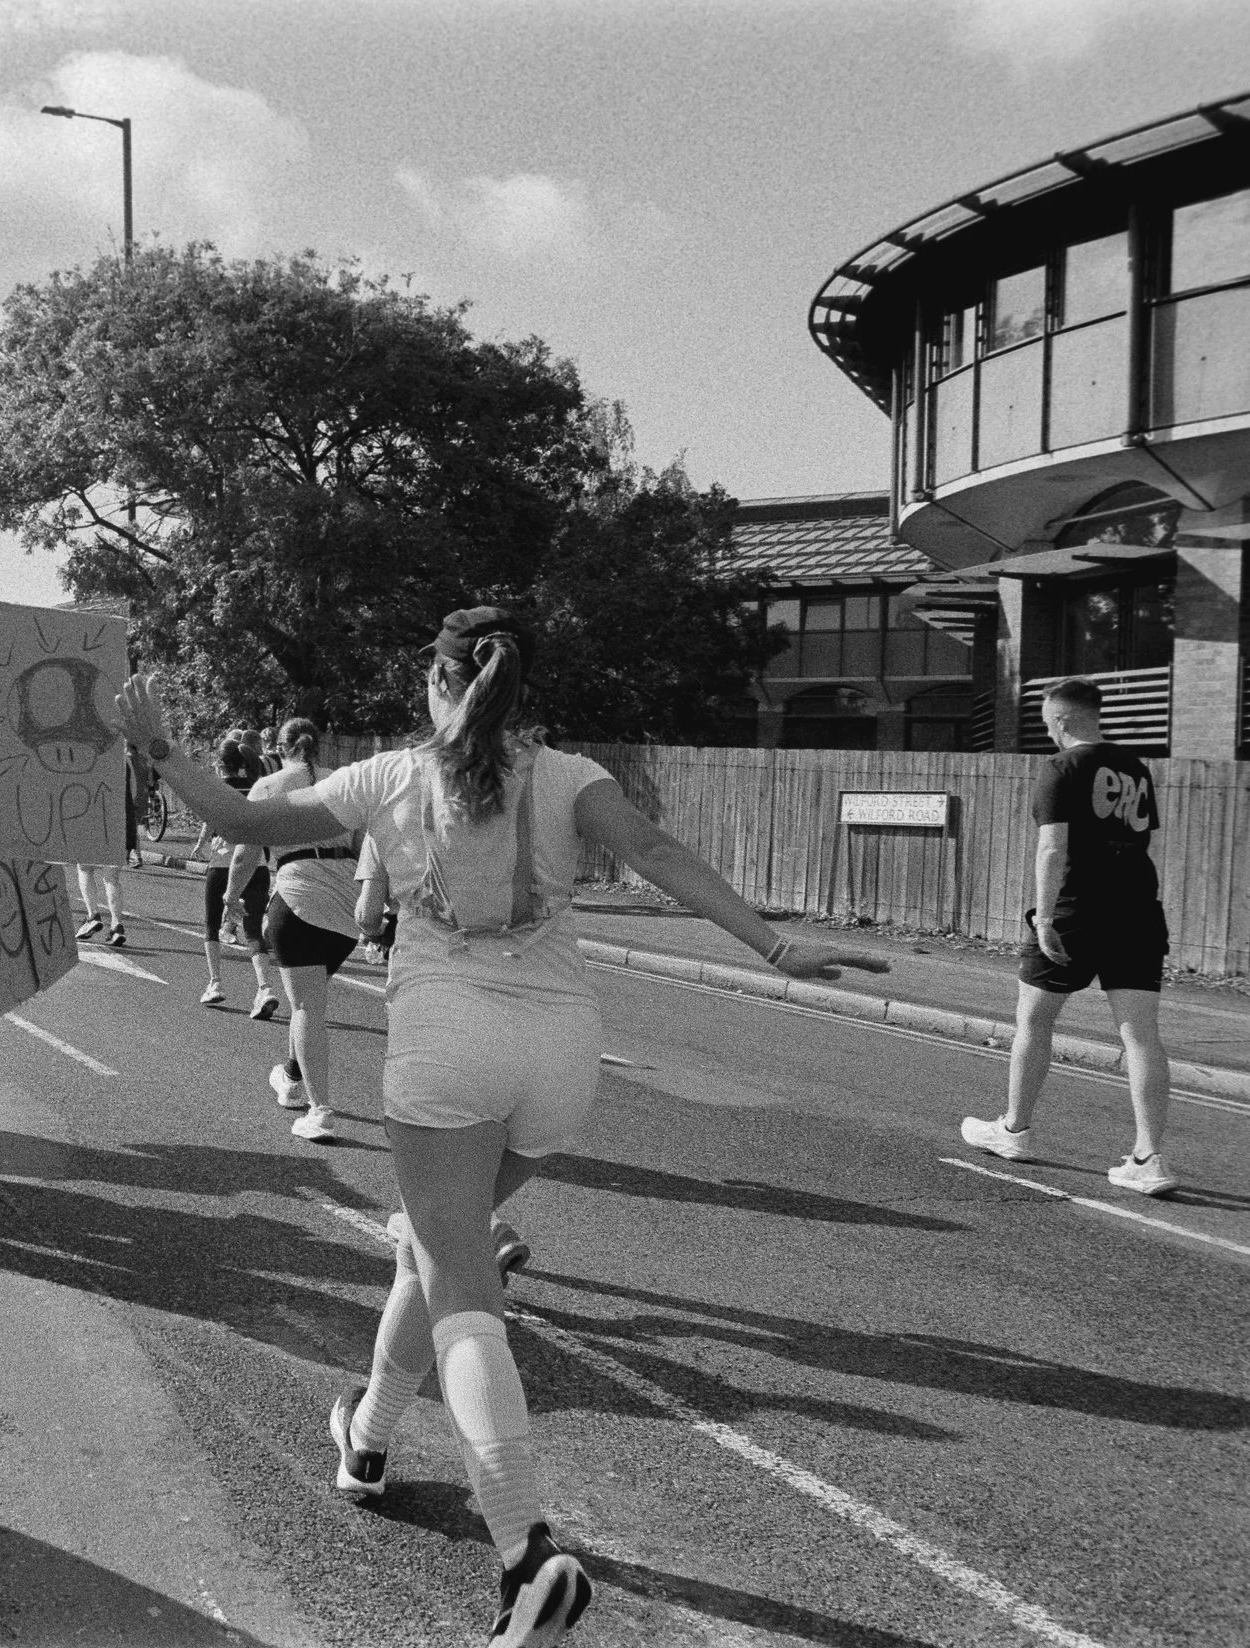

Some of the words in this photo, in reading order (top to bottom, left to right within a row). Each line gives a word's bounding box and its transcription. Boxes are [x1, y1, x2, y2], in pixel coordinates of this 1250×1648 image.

[844, 795, 890, 808] WILFORD
[893, 795, 934, 808] STREET
[858, 808, 905, 821] WILFORD
[909, 809, 940, 822] ROAD
